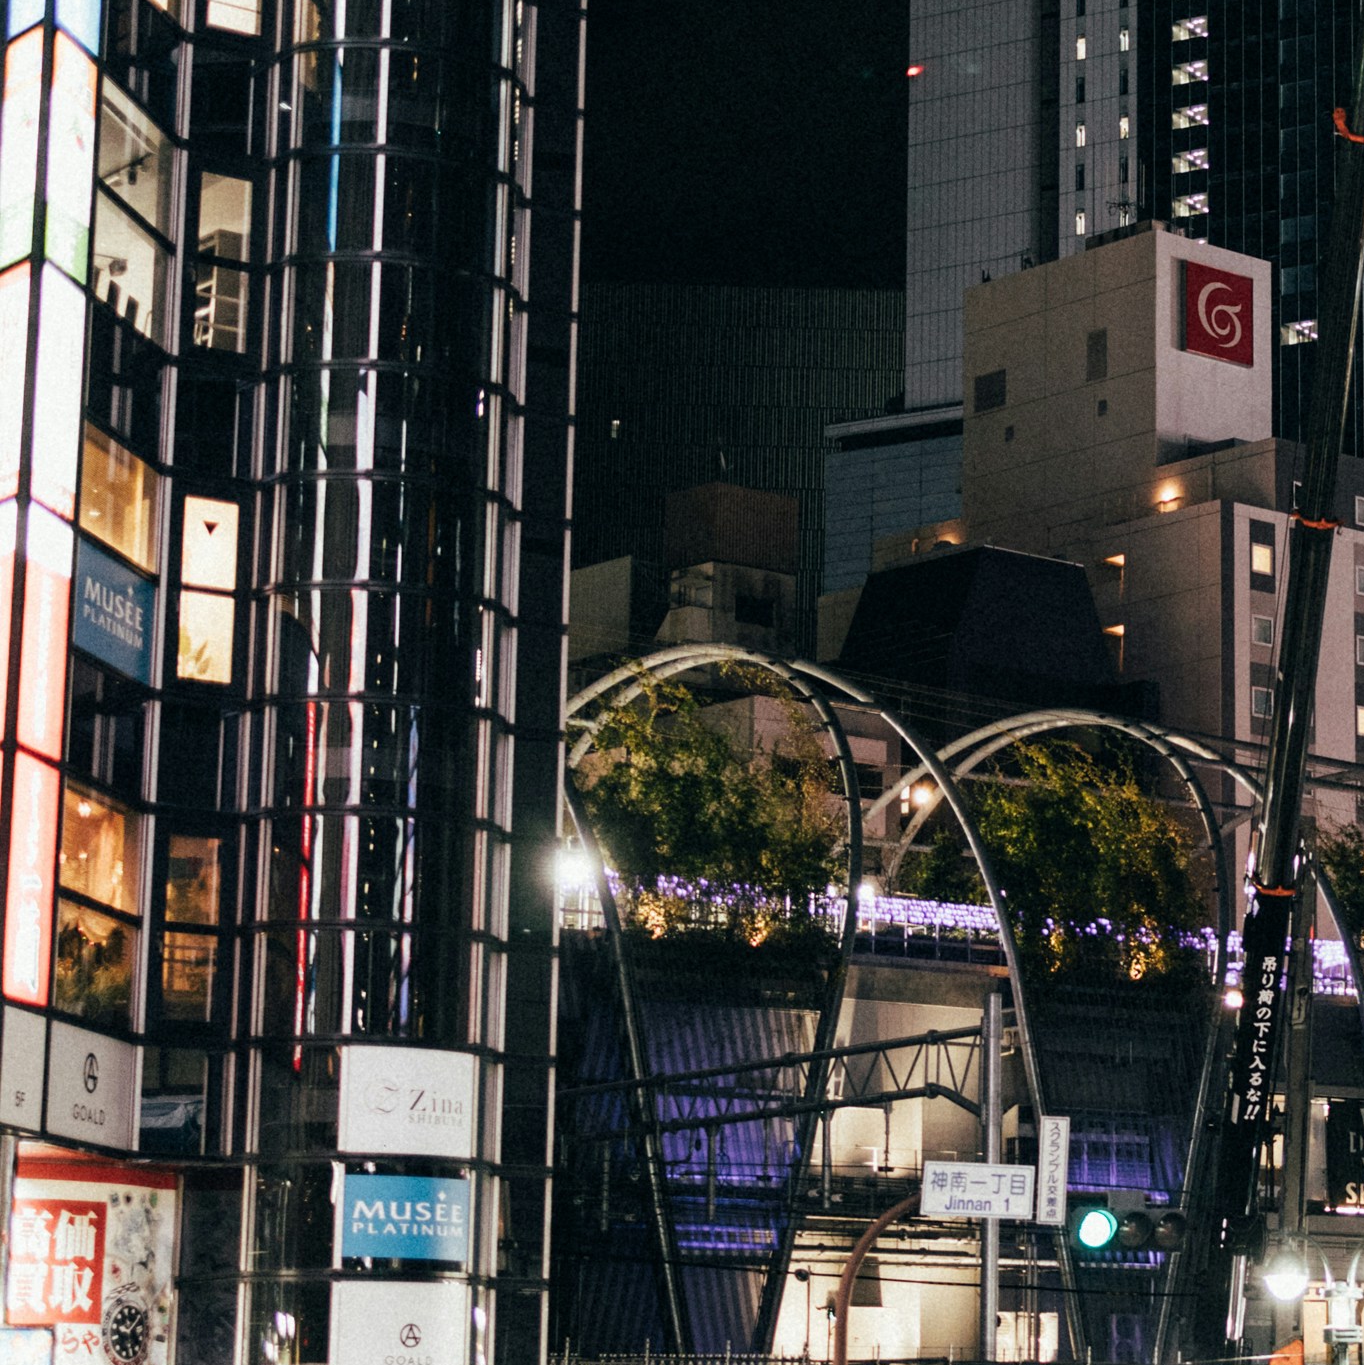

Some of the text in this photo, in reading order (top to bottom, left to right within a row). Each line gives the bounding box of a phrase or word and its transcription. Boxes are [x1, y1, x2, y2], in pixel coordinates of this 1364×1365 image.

[83, 604, 143, 650] PLATINUM
[410, 1089, 463, 1114] Zina
[72, 1103, 106, 1126] GOALD
[408, 1113, 464, 1127] SHIBUYA
[930, 1169, 1027, 1196] 神南一丁目
[1046, 1122, 1061, 1219] スクランブル交差点
[944, 1195, 1010, 1213] Jinnan 1
[11, 1207, 98, 1260] 高価
[352, 1222, 463, 1237] PLATINUM
[7, 1260, 95, 1315] 買取
[384, 1355, 433, 1365] GOALD
